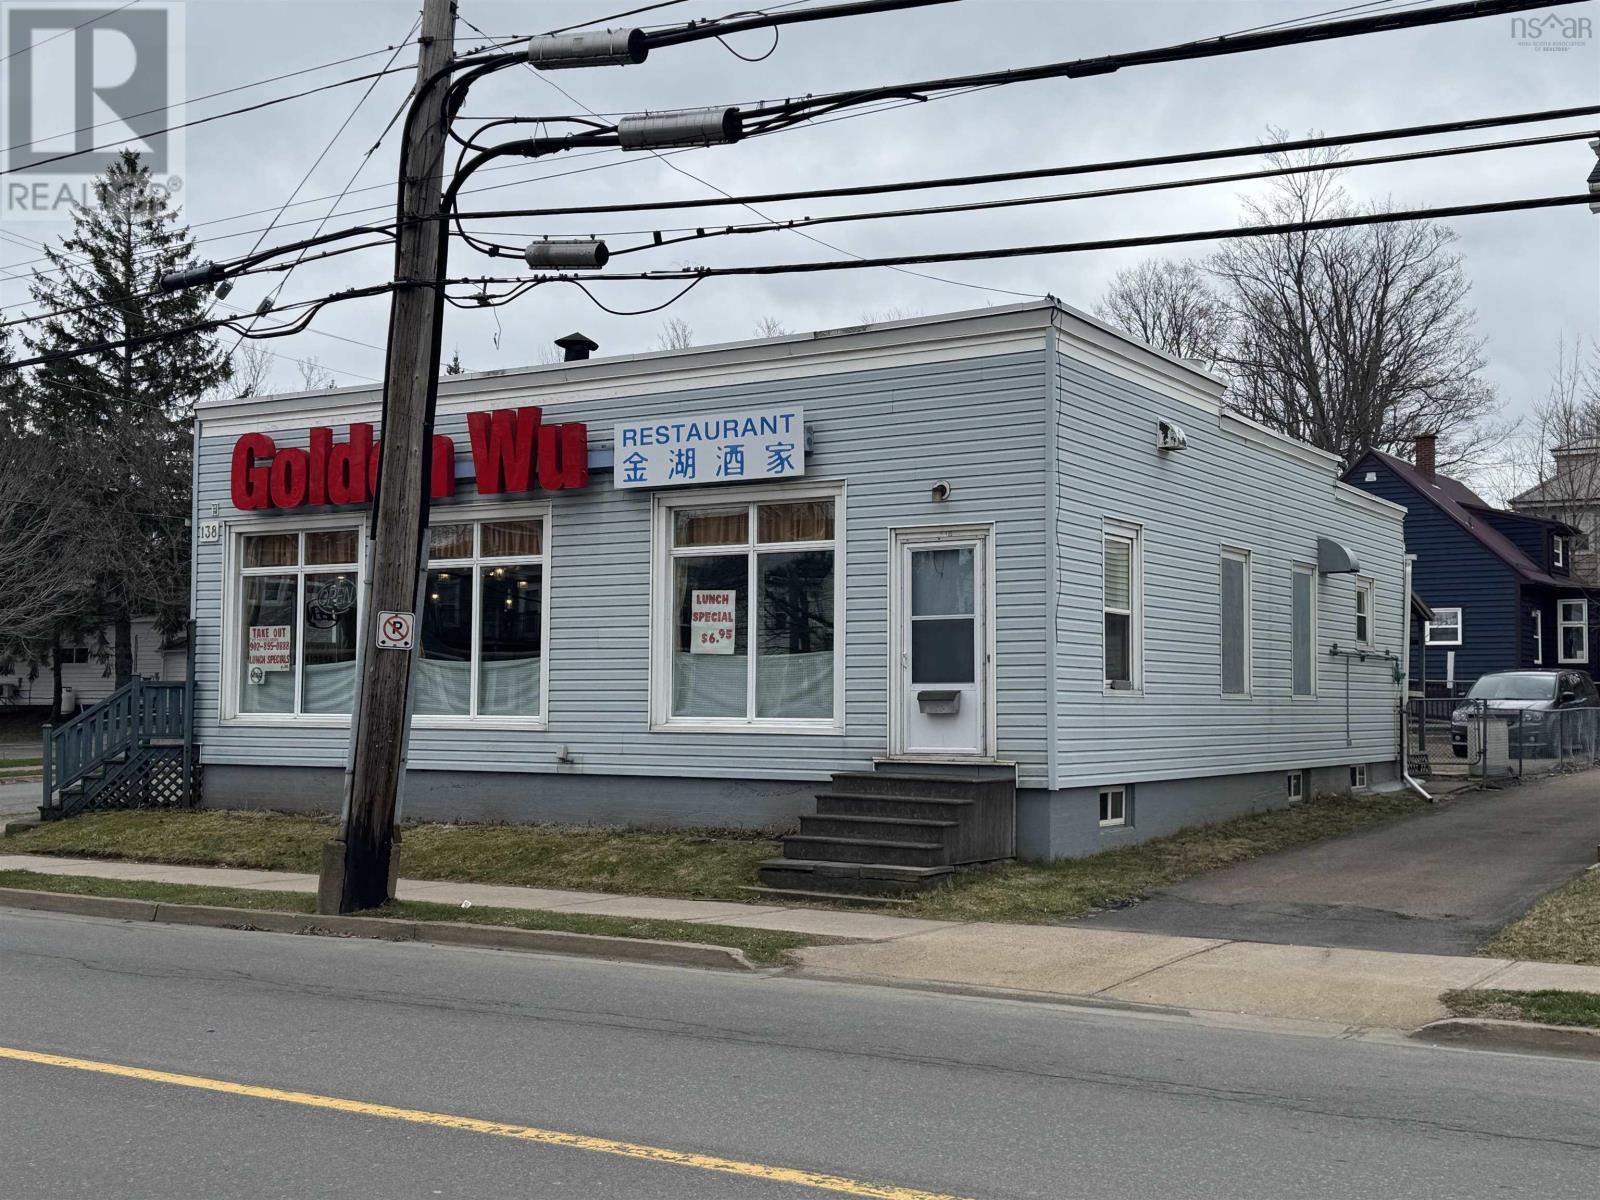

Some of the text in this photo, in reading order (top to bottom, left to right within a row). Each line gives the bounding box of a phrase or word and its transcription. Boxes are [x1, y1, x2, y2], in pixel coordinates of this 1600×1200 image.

[622, 413, 795, 447] RESTAURANT
[231, 406, 588, 511] Goldn Wu
[623, 441, 795, 483] 金湖酒家
[201, 525, 217, 539] 138
[696, 594, 729, 605] LUNCH
[692, 611, 733, 622] SPECIAL
[252, 628, 286, 638] TAKE OUT
[701, 628, 733, 644] $6.95
[250, 655, 265, 665] LUNCH
